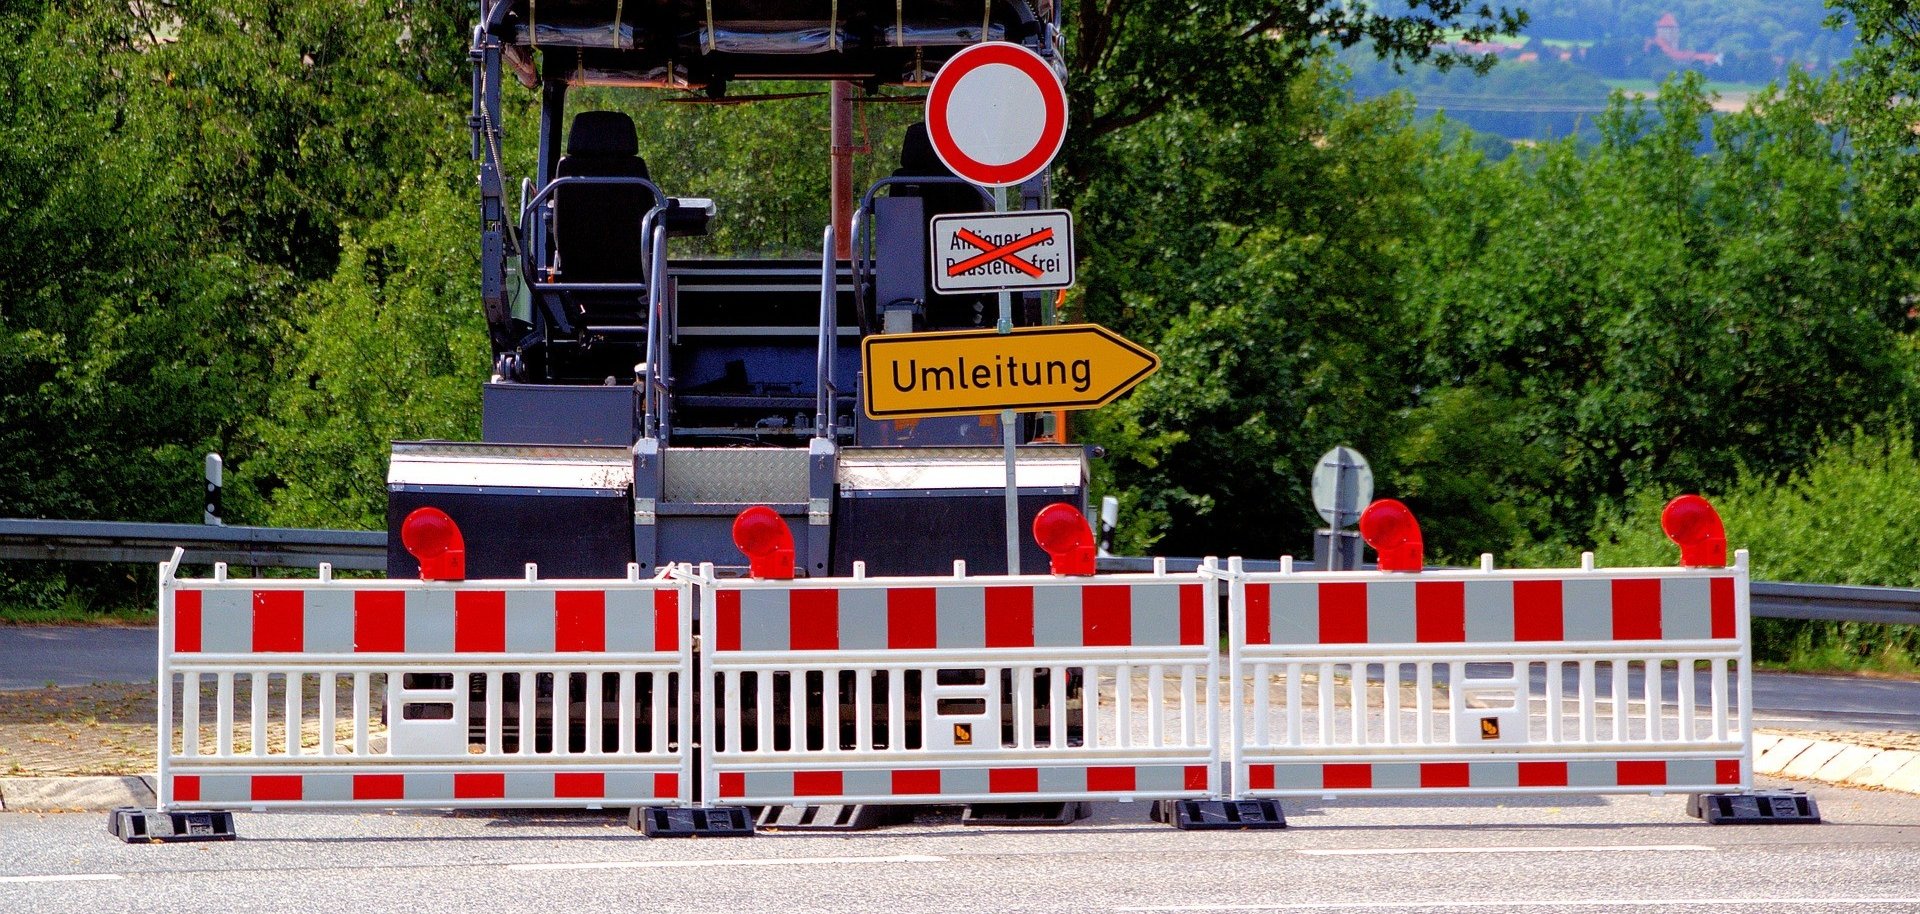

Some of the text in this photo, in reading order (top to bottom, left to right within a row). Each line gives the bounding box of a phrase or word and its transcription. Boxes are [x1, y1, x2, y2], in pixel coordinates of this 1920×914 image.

[950, 230, 1021, 251] Aneger
[946, 253, 1060, 277] ustel frei
[892, 355, 1091, 393] Umleitung
